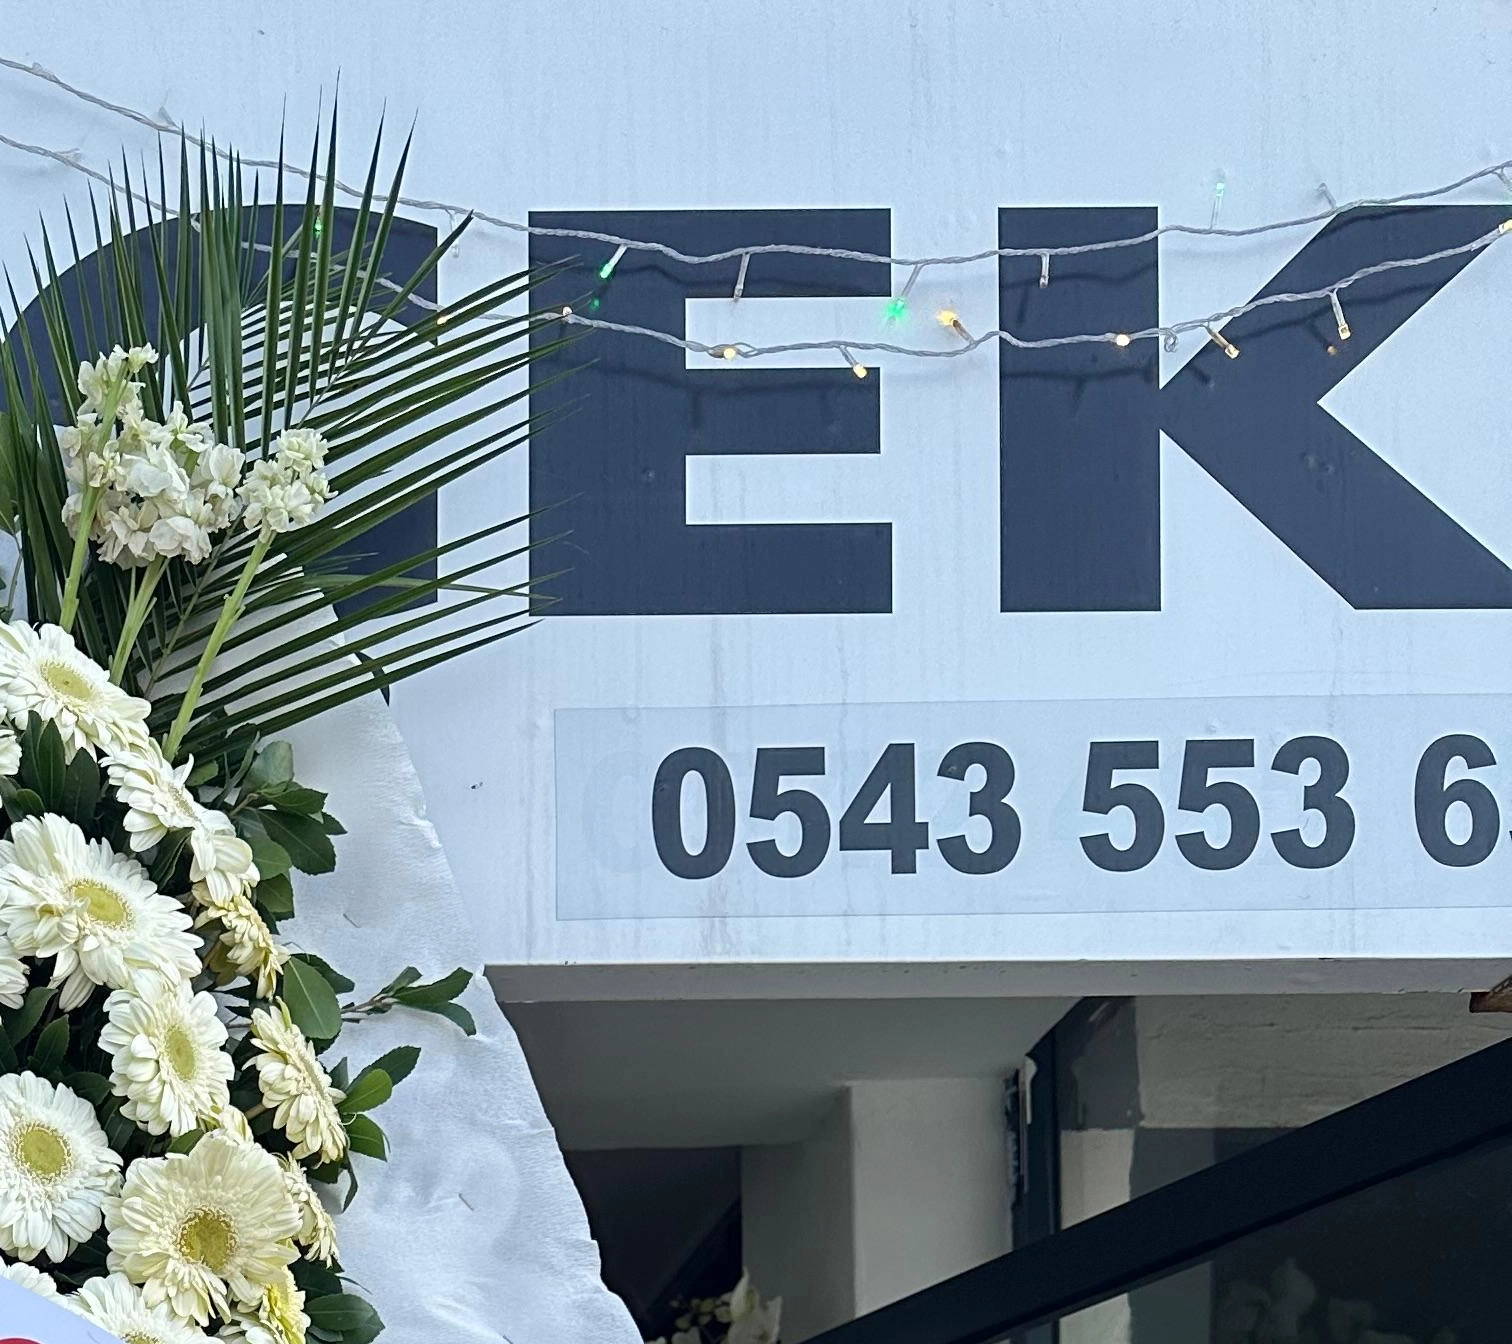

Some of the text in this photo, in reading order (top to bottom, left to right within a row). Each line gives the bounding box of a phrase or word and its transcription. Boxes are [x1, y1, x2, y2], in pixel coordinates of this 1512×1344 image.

[651, 733, 1512, 880] 0543 553 6
